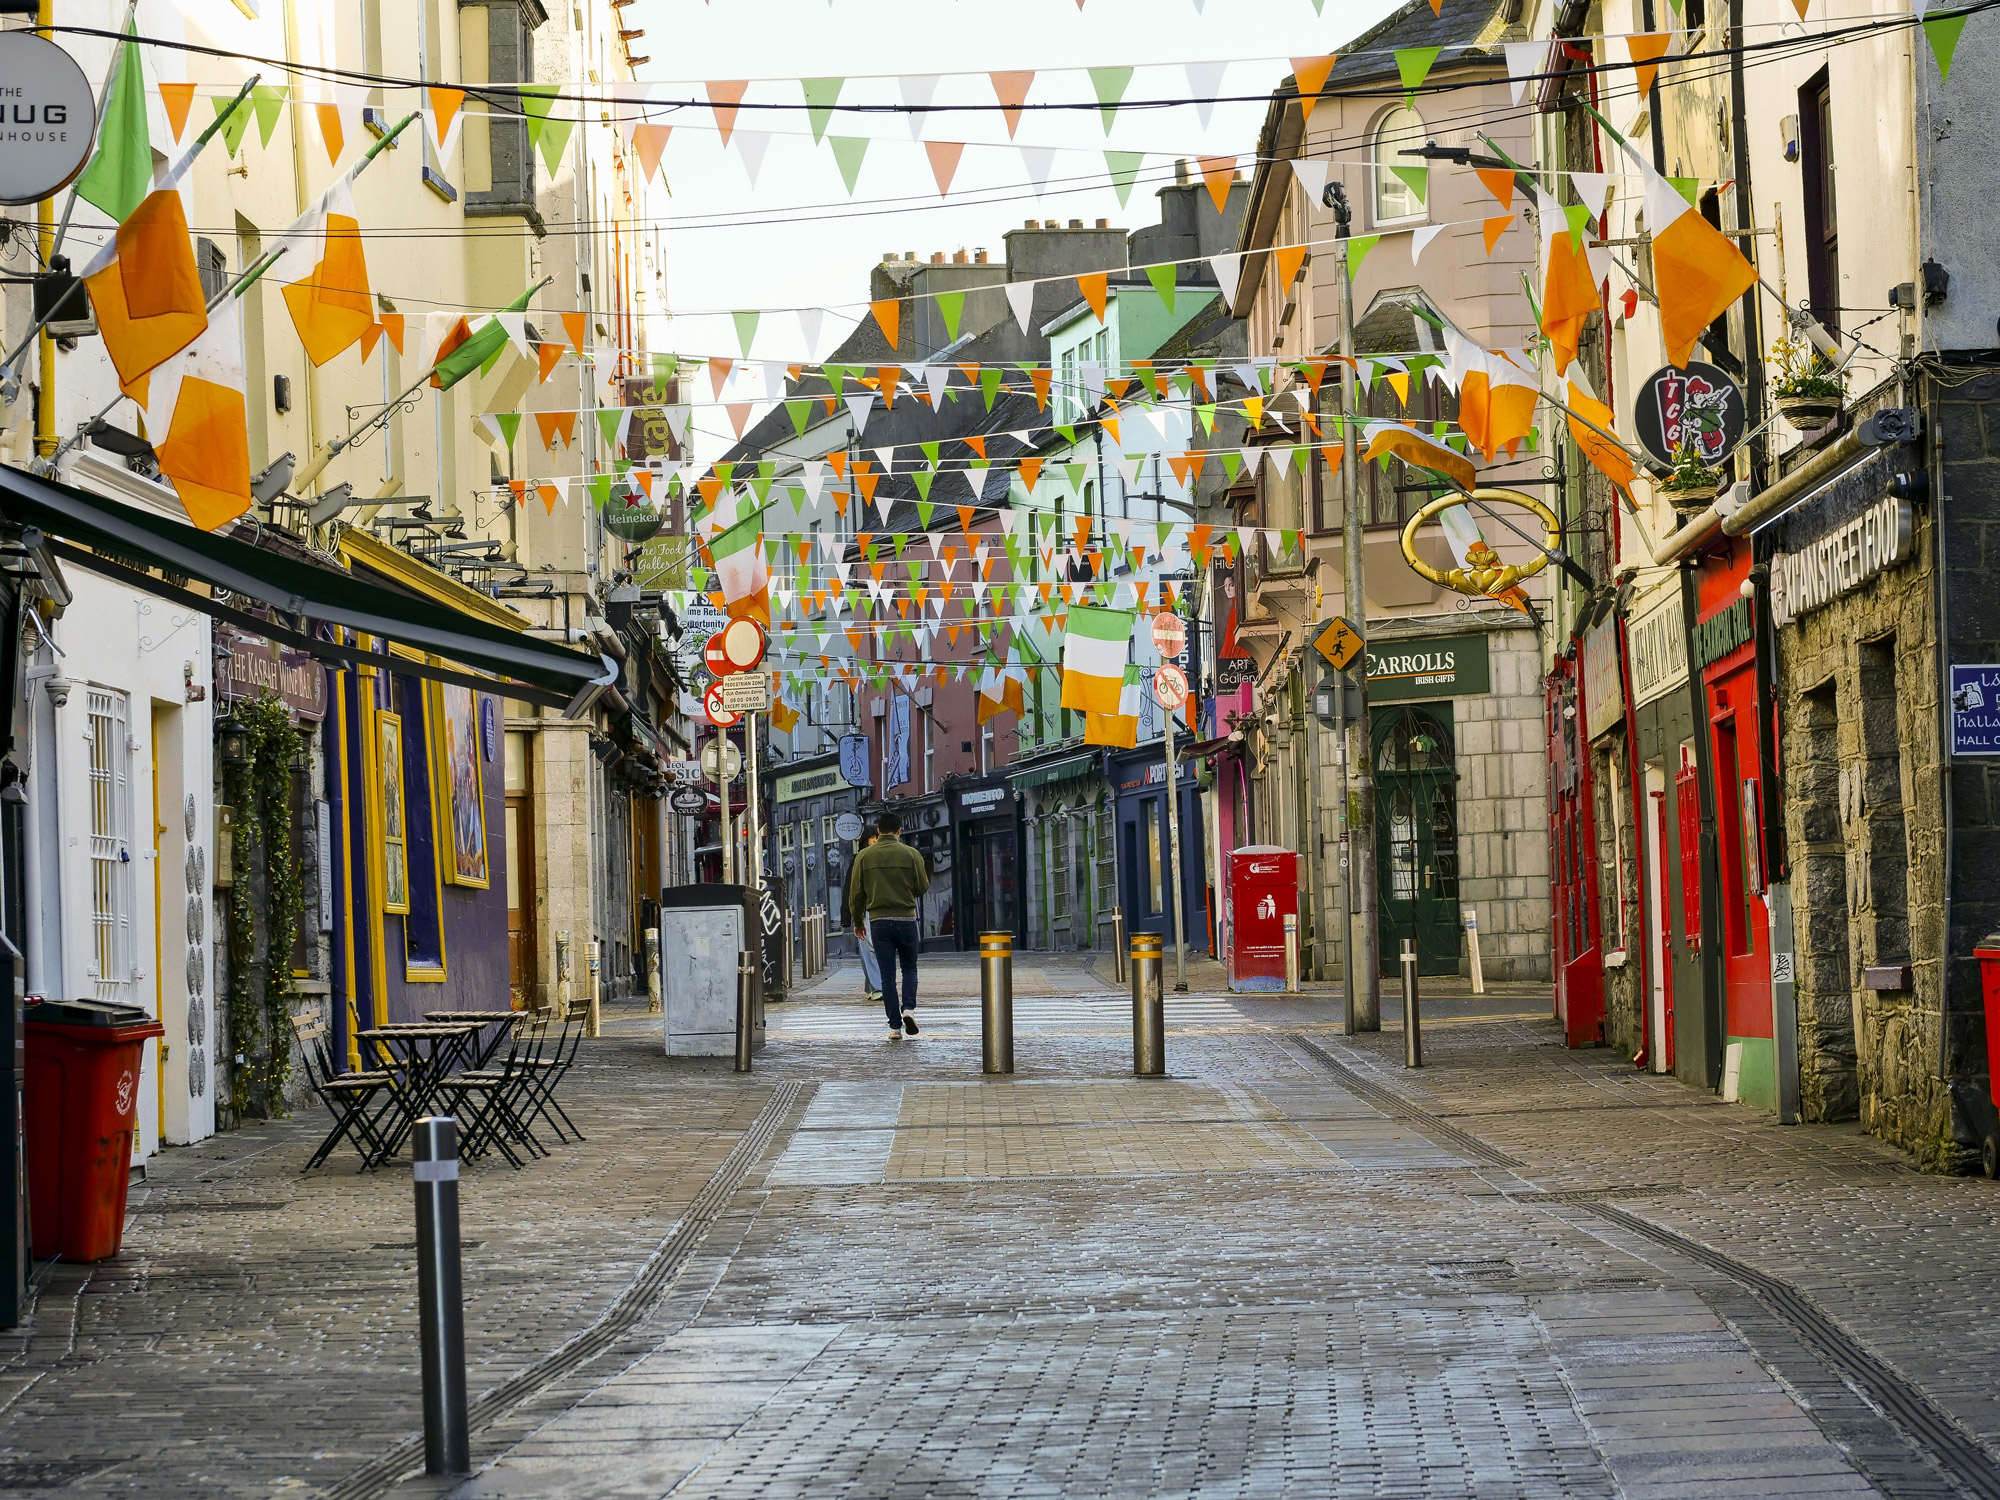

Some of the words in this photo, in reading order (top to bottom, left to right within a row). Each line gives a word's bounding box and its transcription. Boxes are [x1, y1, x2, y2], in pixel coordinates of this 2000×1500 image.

[0, 105, 66, 124] UG
[608, 513, 660, 525] Heineken
[657, 542, 683, 556] Food
[1819, 516, 1863, 602] STREET
[1866, 497, 1898, 575] FOOD
[638, 557, 678, 574] Gallery
[1215, 559, 1235, 569] HIG
[688, 608, 701, 616] ime
[704, 607, 727, 616] Retail
[1229, 660, 1248, 670] ART
[1367, 651, 1455, 676] CARROLLS
[248, 651, 278, 691] KASBAH
[298, 667, 313, 699] BAR
[1219, 668, 1259, 684] Gallery
[1415, 676, 1434, 685] IRISH
[1435, 674, 1455, 684] GIFTS
[1957, 736, 1990, 745] HALL
[672, 769, 700, 779] SIC
